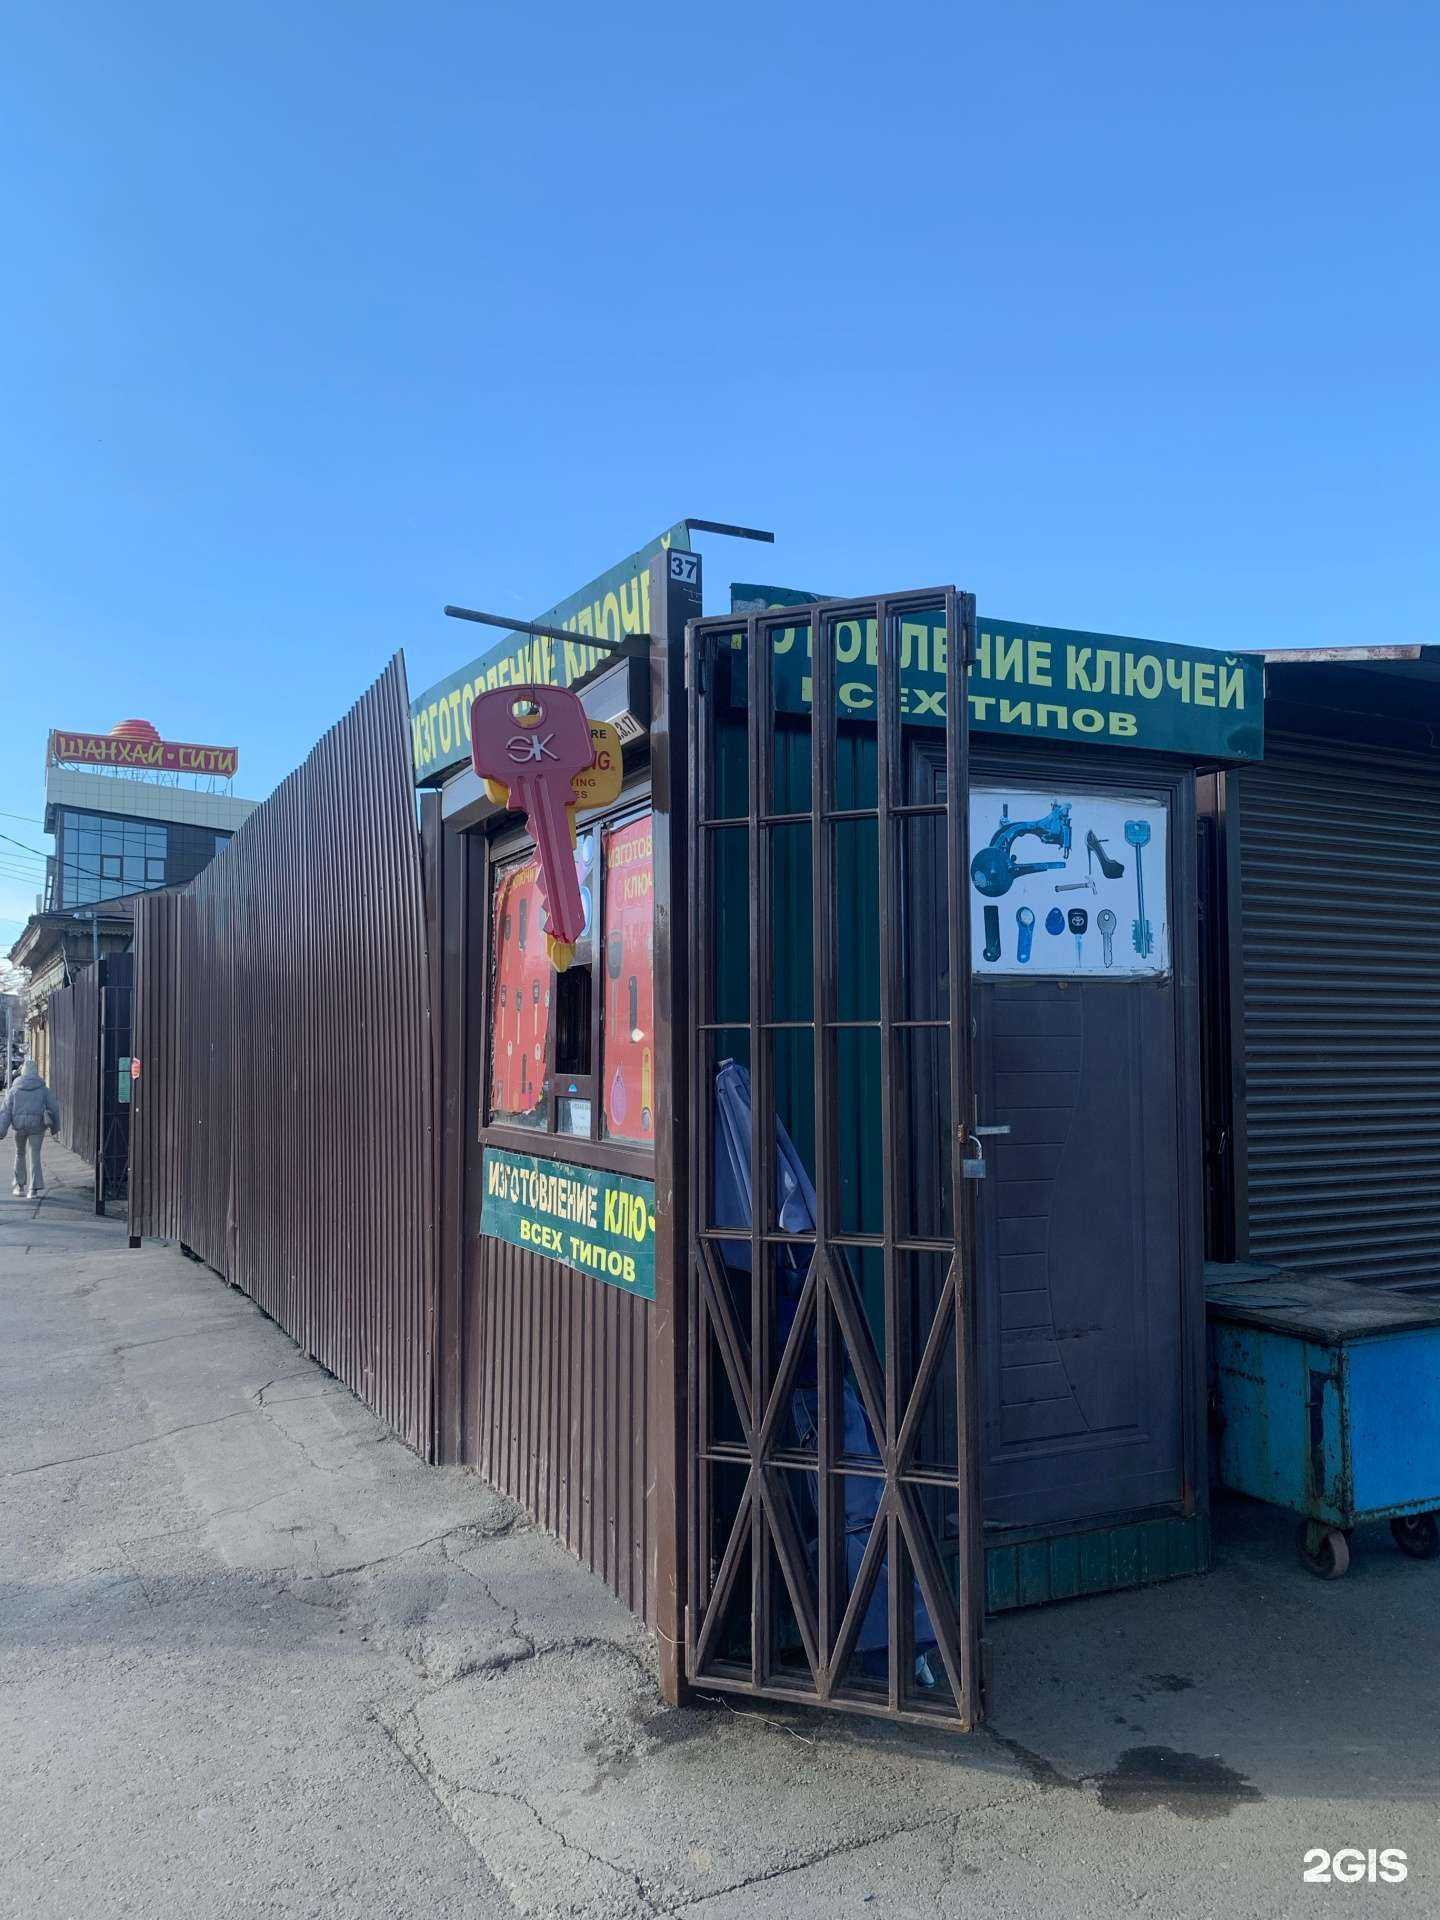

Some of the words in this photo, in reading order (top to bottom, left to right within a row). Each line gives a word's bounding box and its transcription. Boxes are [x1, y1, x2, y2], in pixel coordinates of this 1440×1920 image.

[671, 557, 698, 579] 37
[1066, 644, 1246, 710] КЛЮЧЕЙ
[967, 695, 1138, 737] ТИПОВ
[59, 736, 165, 767] ШАНХАЙ
[179, 748, 234, 772] СИТИ
[487, 1160, 599, 1229] ИЗГОТОВЛЕНИЕ
[604, 1188, 656, 1242] КЛЮ
[519, 1218, 564, 1254] ВСЕХ
[569, 1236, 636, 1282] ТИПОВ
